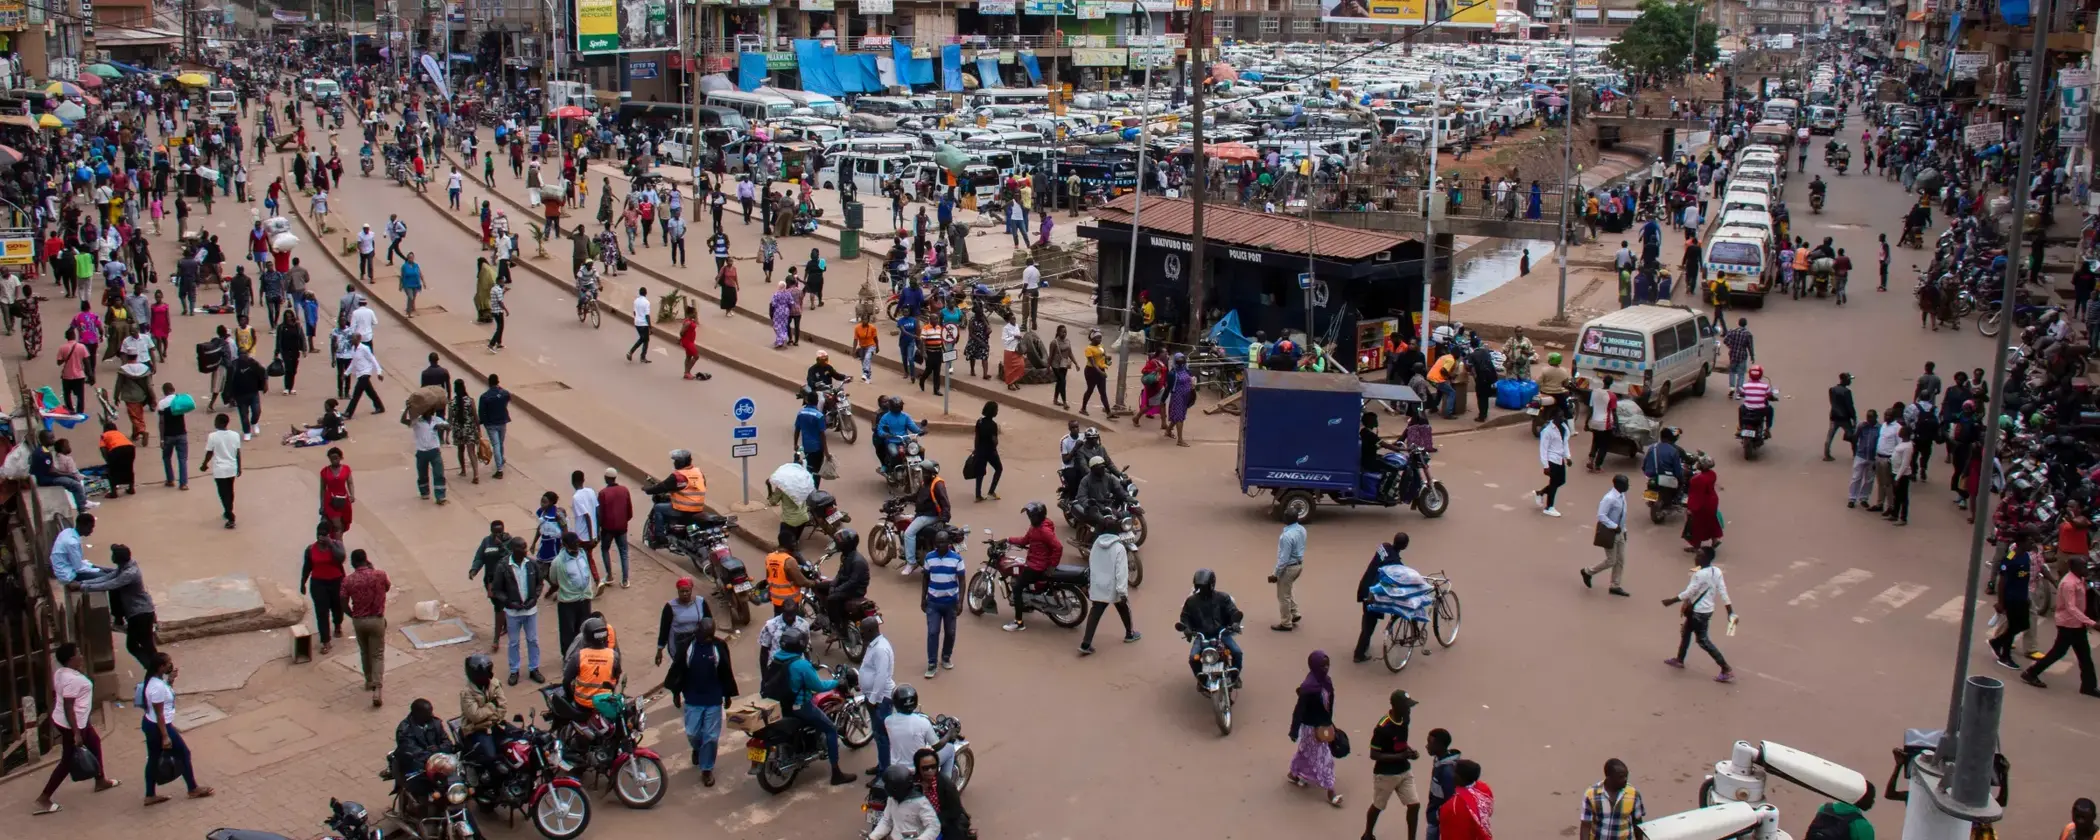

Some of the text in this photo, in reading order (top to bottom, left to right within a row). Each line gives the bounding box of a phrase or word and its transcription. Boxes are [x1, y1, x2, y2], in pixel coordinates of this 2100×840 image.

[82, 0, 94, 32] OWER
[589, 39, 608, 48] Sprite
[1151, 237, 1181, 250] NAKIVUBO
[1229, 249, 1262, 263] POLICE POST
[1266, 471, 1332, 481] ZONGSHEN
[593, 666, 599, 677] 4
